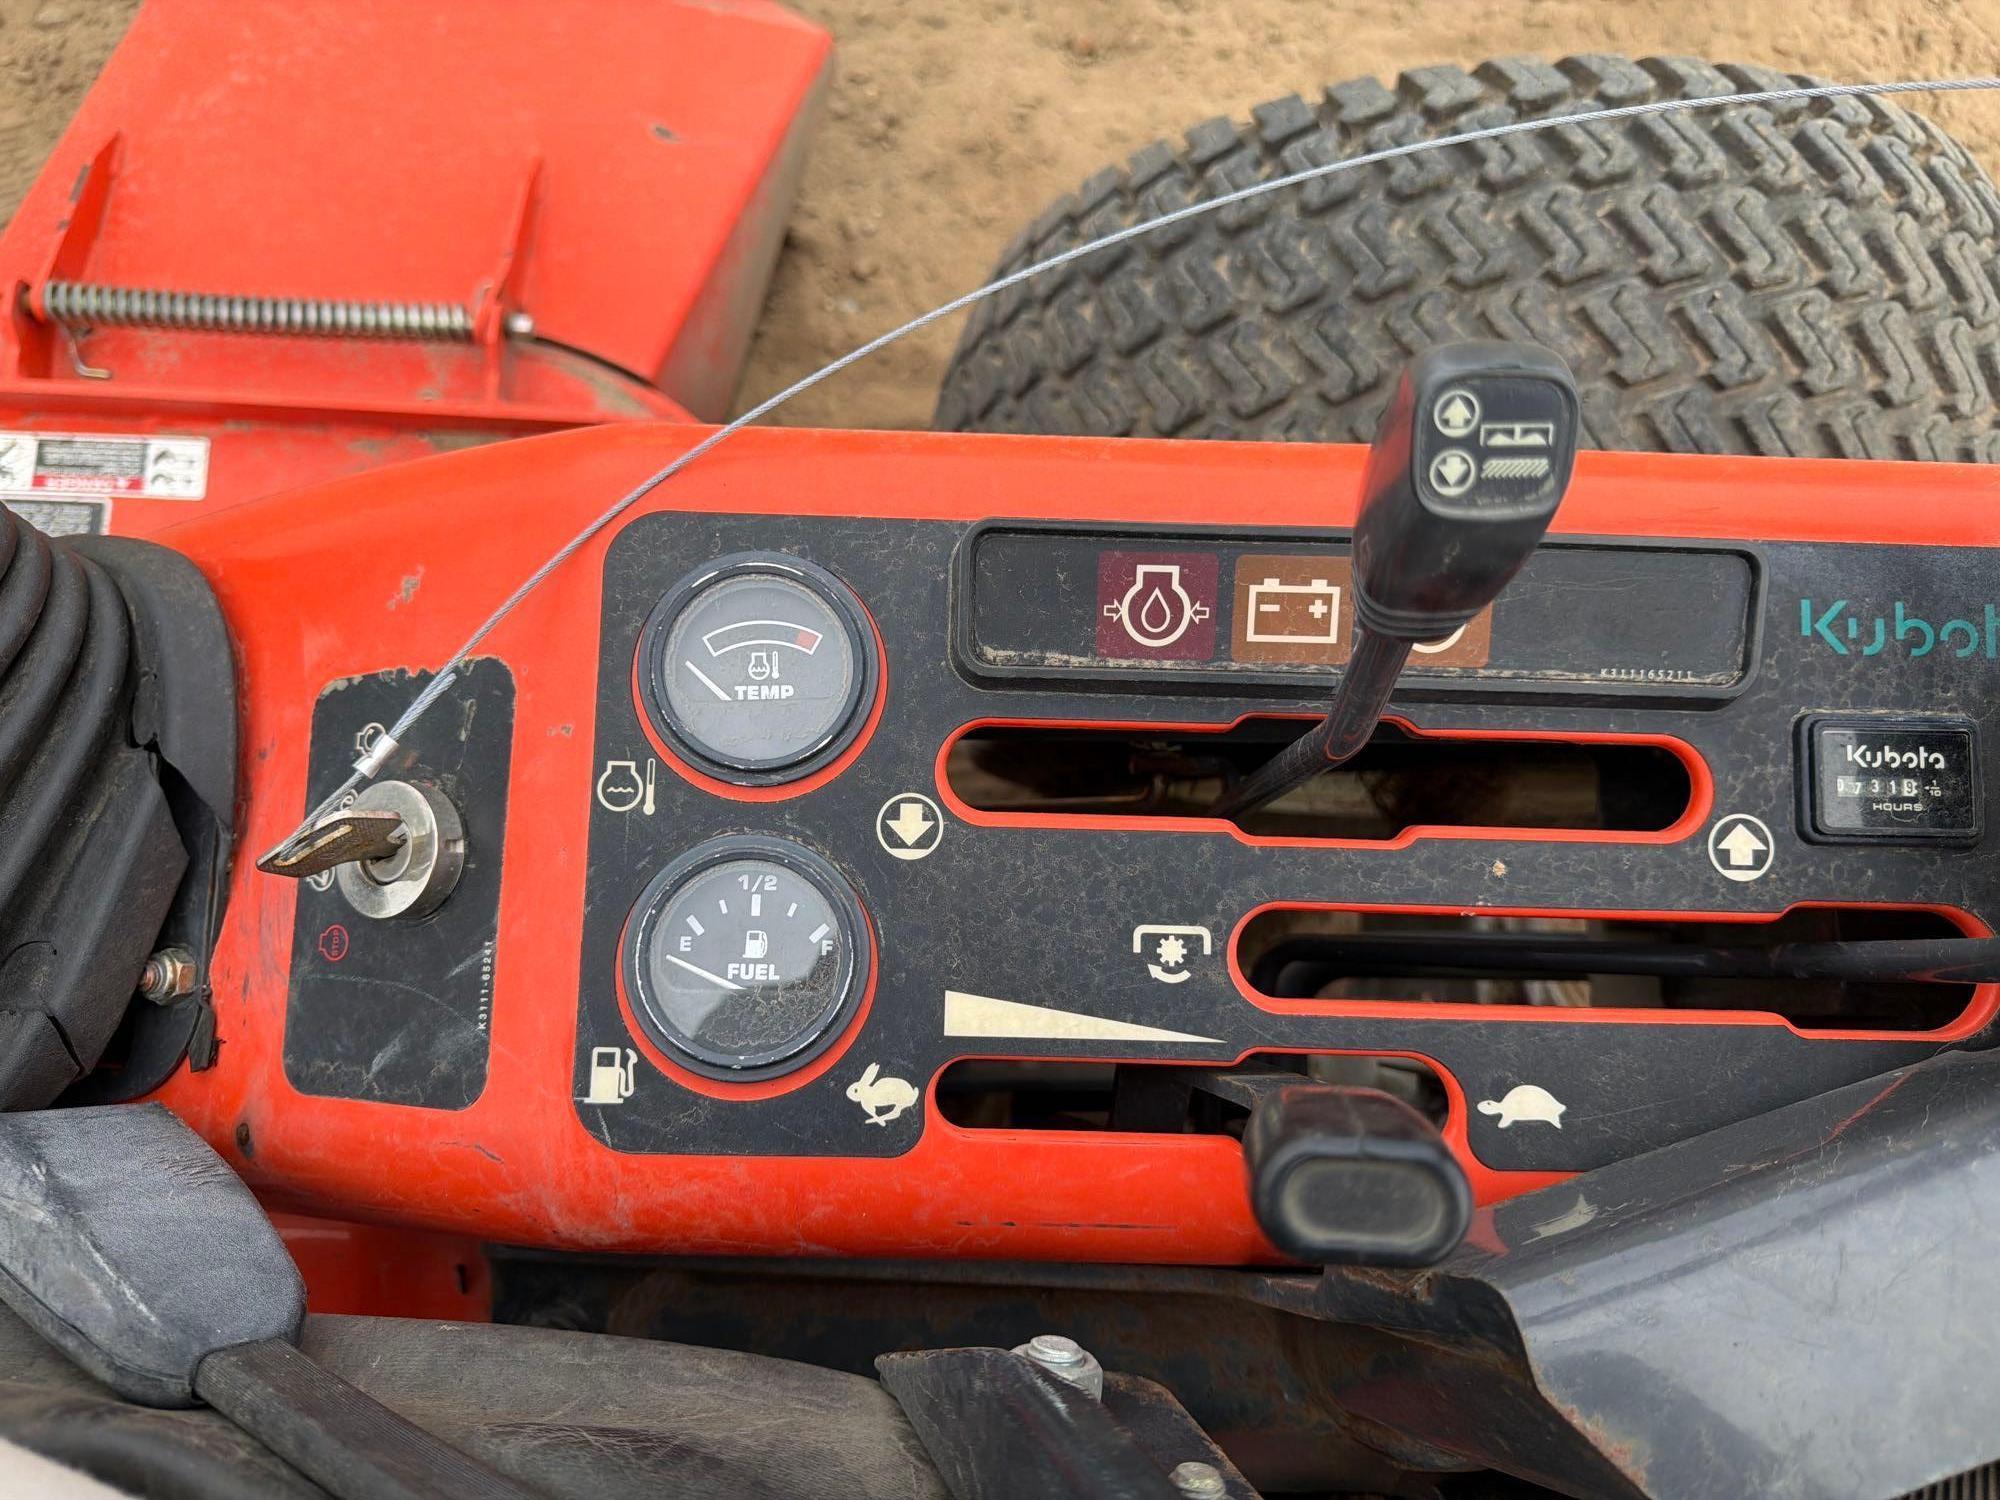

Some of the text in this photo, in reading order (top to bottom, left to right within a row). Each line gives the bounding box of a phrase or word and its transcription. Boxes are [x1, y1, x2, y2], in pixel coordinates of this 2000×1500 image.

[1801, 599, 2000, 659] Kubot
[733, 685, 795, 701] TEMP
[1846, 744, 1946, 769] Kubota
[1872, 802, 1924, 812] HOURS
[738, 874, 778, 892] 1/2
[331, 929, 340, 957] STOP
[679, 936, 692, 952] E
[821, 939, 834, 956] F
[727, 963, 780, 981] FUEL
[478, 940, 494, 1031] K3111-65241
